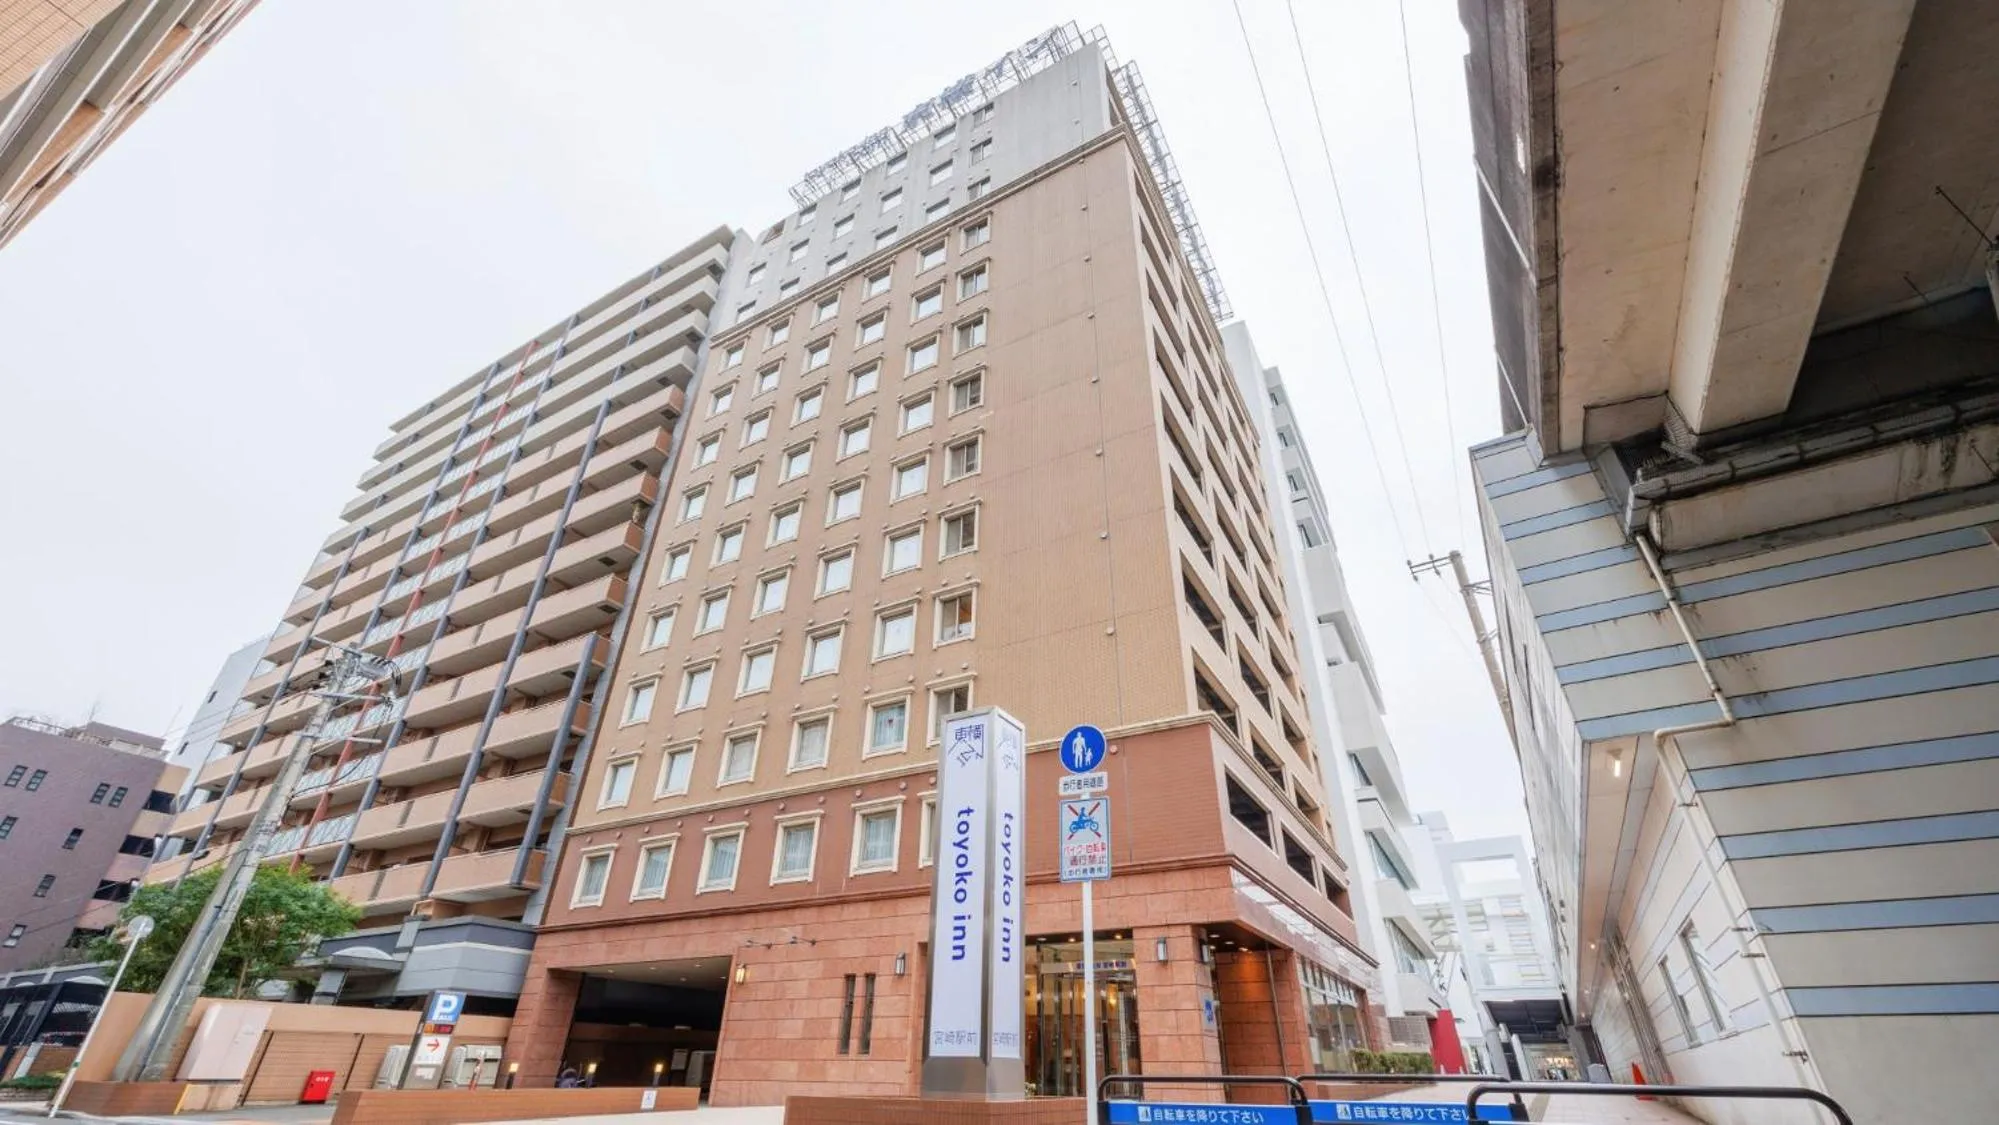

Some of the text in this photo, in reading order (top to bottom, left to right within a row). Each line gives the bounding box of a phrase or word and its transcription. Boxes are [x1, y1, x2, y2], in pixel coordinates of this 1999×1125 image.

[952, 806, 975, 961] toyoko inn
[1001, 812, 1013, 963] toyoko inn
[432, 994, 458, 1021] P
[1153, 1107, 1264, 1124] 自転車を降りて下さい
